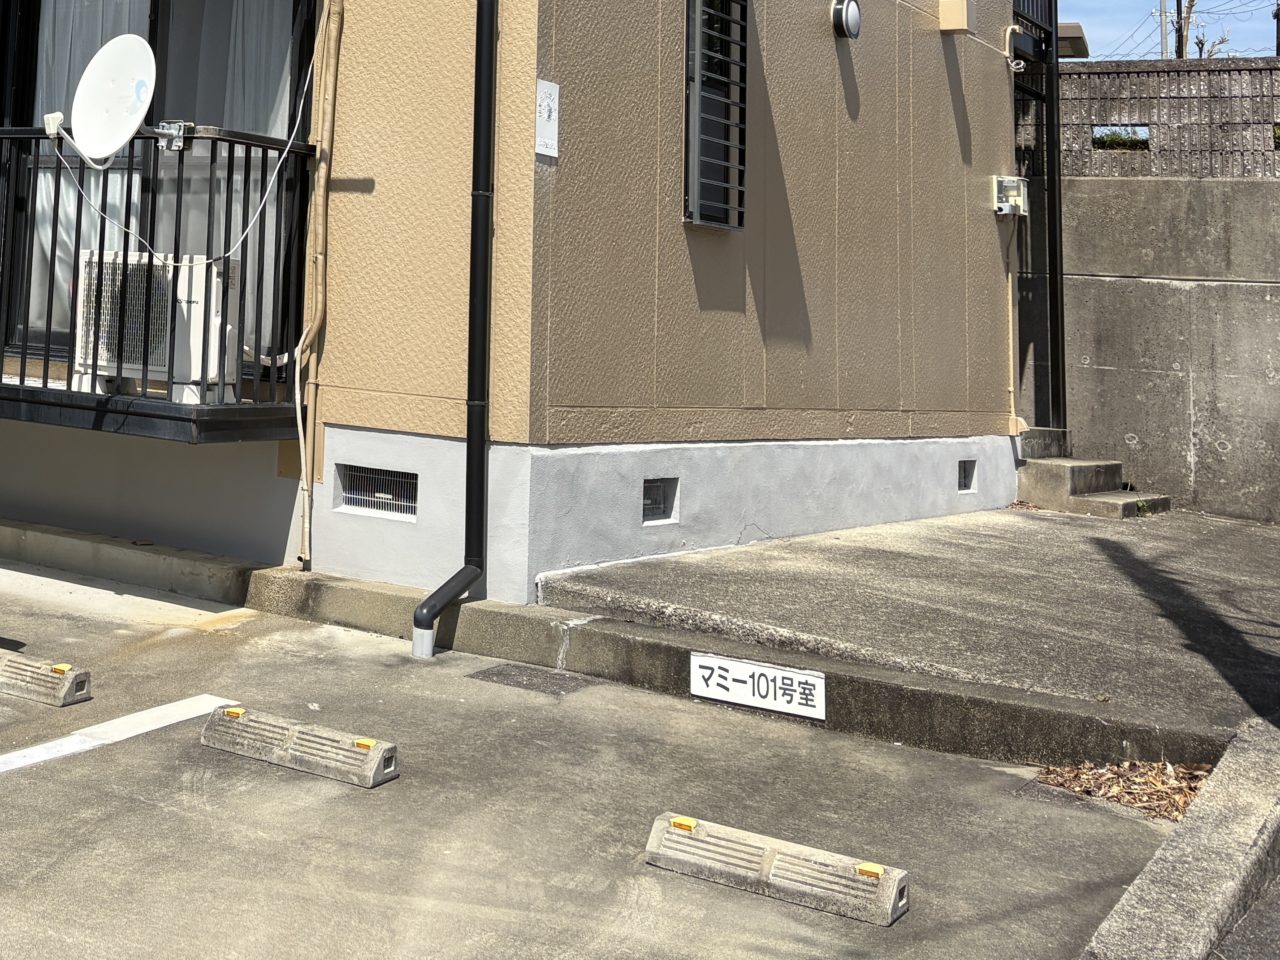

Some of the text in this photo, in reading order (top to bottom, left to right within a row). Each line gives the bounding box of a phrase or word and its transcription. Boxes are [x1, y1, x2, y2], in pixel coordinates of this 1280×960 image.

[698, 664, 817, 709] マミー101号室
